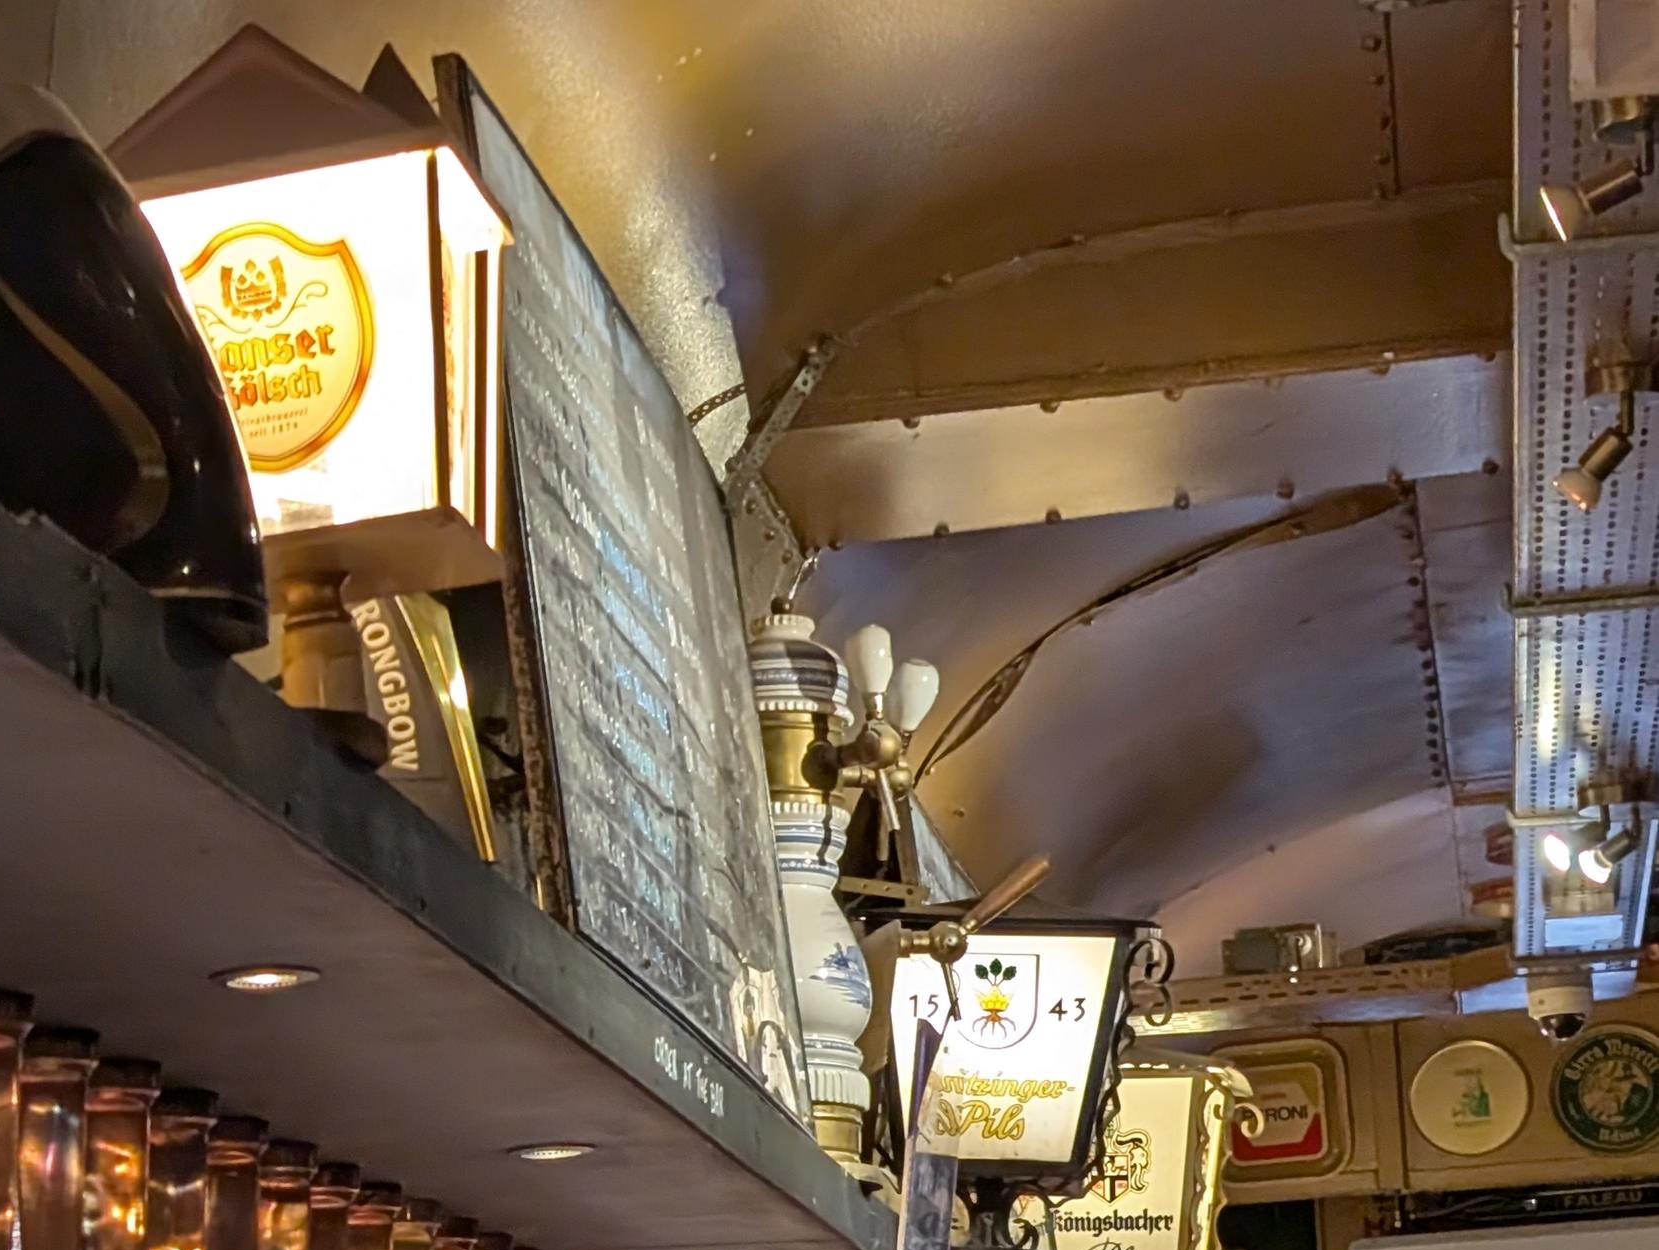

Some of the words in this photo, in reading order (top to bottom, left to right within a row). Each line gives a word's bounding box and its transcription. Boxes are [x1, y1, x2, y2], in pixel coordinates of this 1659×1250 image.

[212, 323, 336, 374] anser
[943, 1099, 1026, 1141] Pils
[1242, 1103, 1309, 1122] PRONI
[1053, 1207, 1175, 1238] Königsbacher
